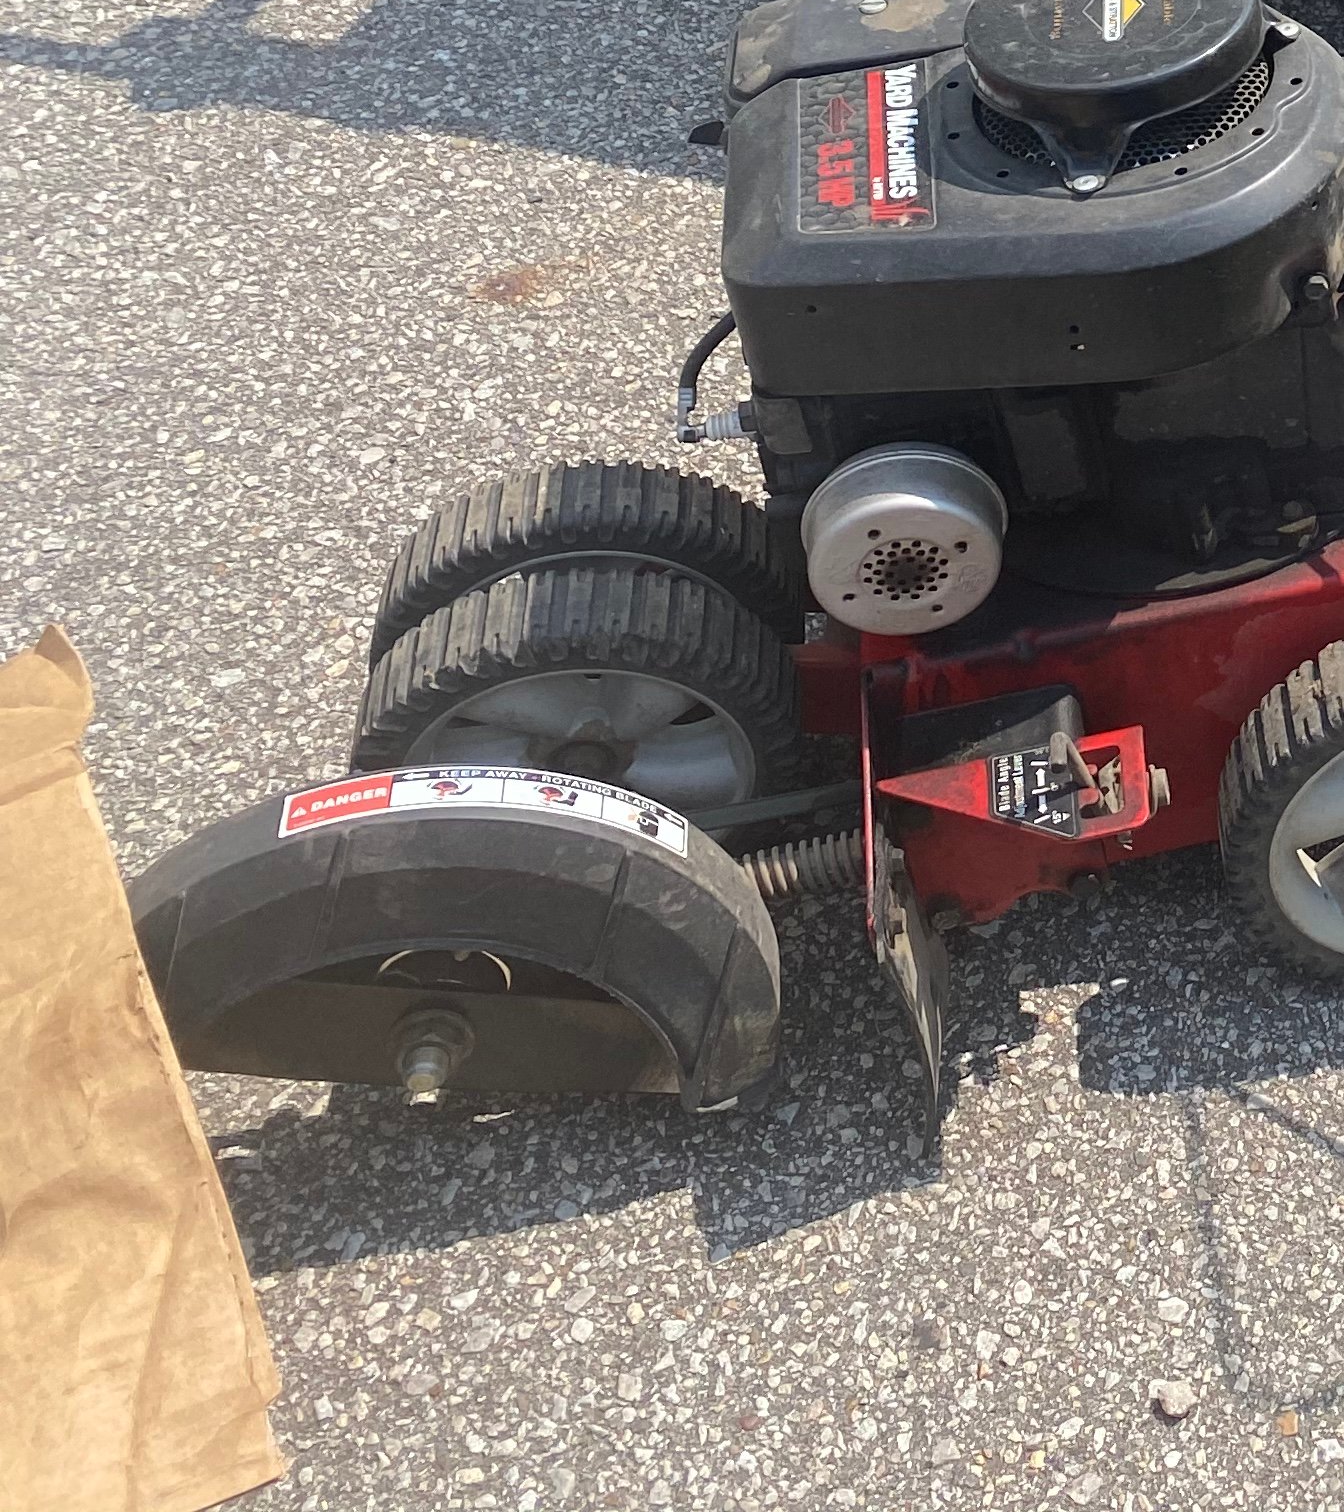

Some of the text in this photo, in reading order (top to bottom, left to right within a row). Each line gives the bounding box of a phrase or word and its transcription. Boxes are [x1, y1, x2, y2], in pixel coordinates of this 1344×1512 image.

[885, 63, 919, 199] YARD MACHINES
[311, 787, 387, 812] DANGER
[438, 770, 658, 814] KEEP AWAY ROTATING BLADE
[997, 757, 1011, 812] Blade Angle
